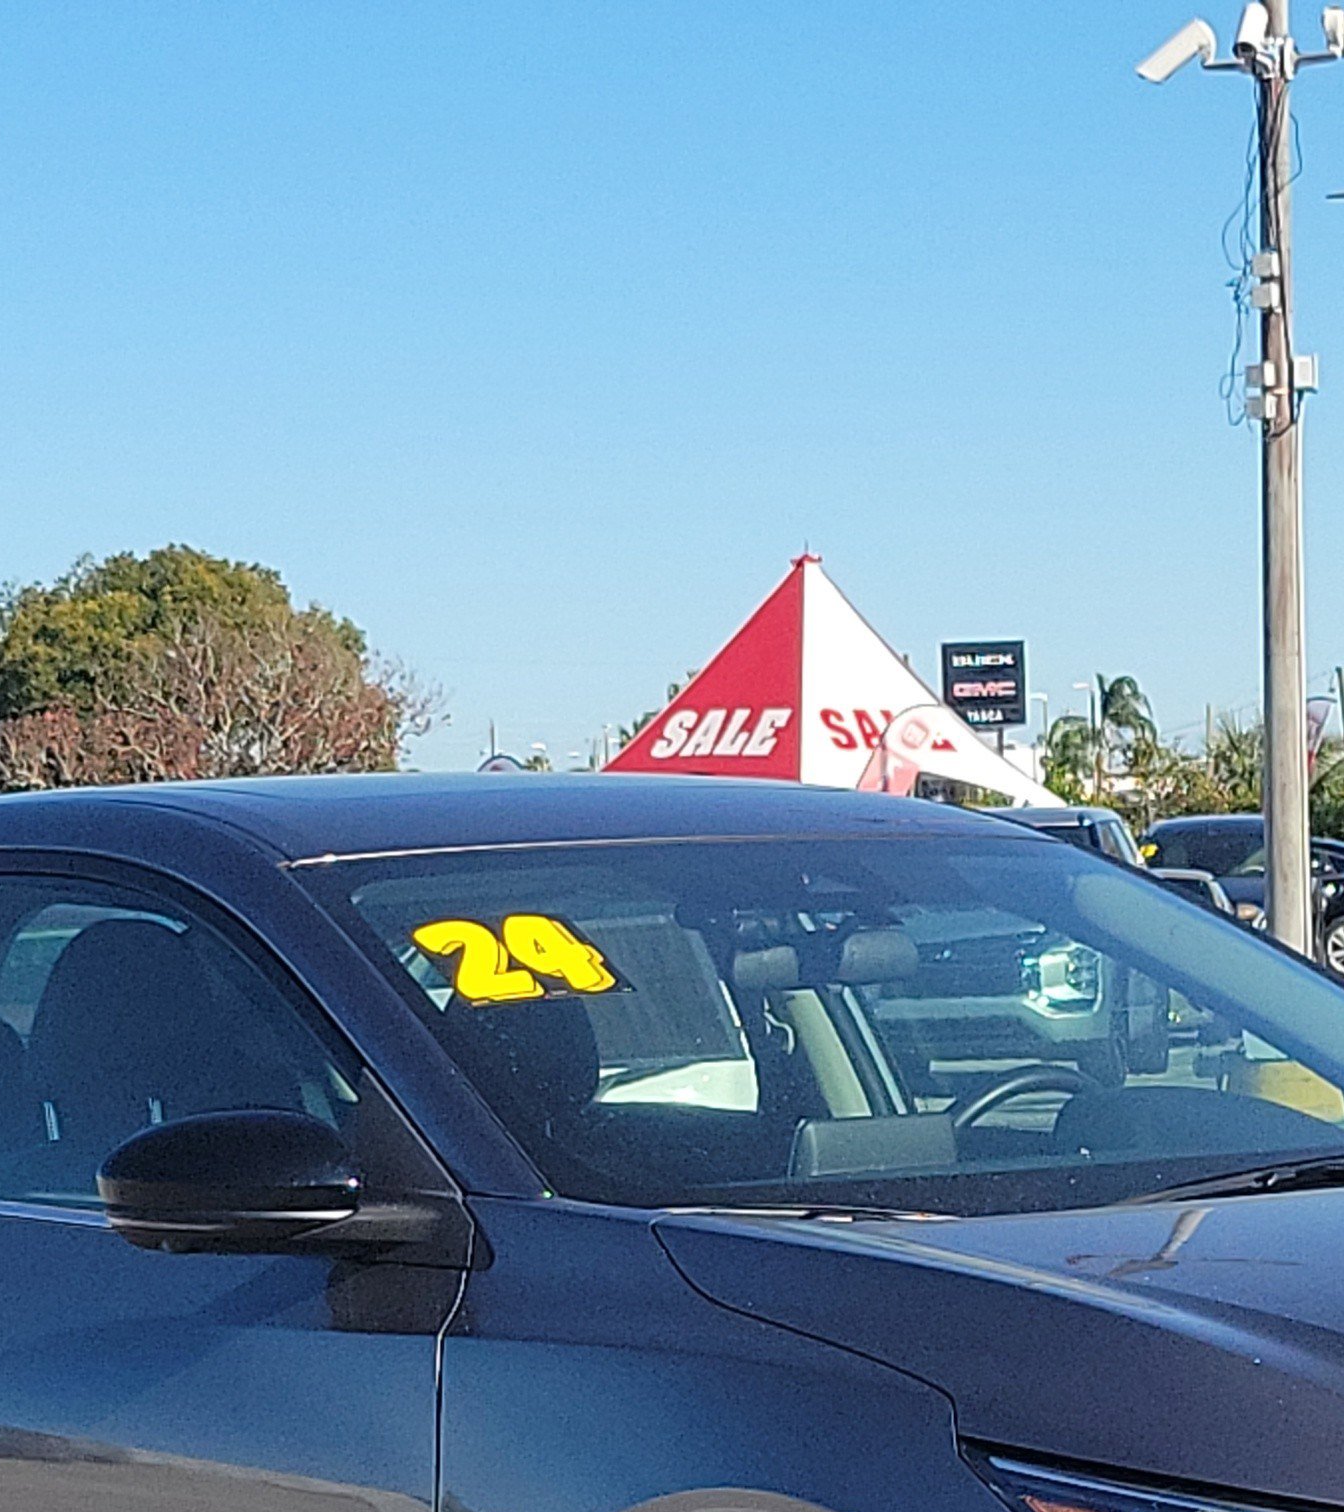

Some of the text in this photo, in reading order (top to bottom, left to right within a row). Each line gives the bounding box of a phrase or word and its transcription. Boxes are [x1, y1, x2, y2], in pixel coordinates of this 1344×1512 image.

[953, 682, 1015, 697] GMC
[650, 709, 792, 759] SALE
[412, 914, 617, 1001] 24
